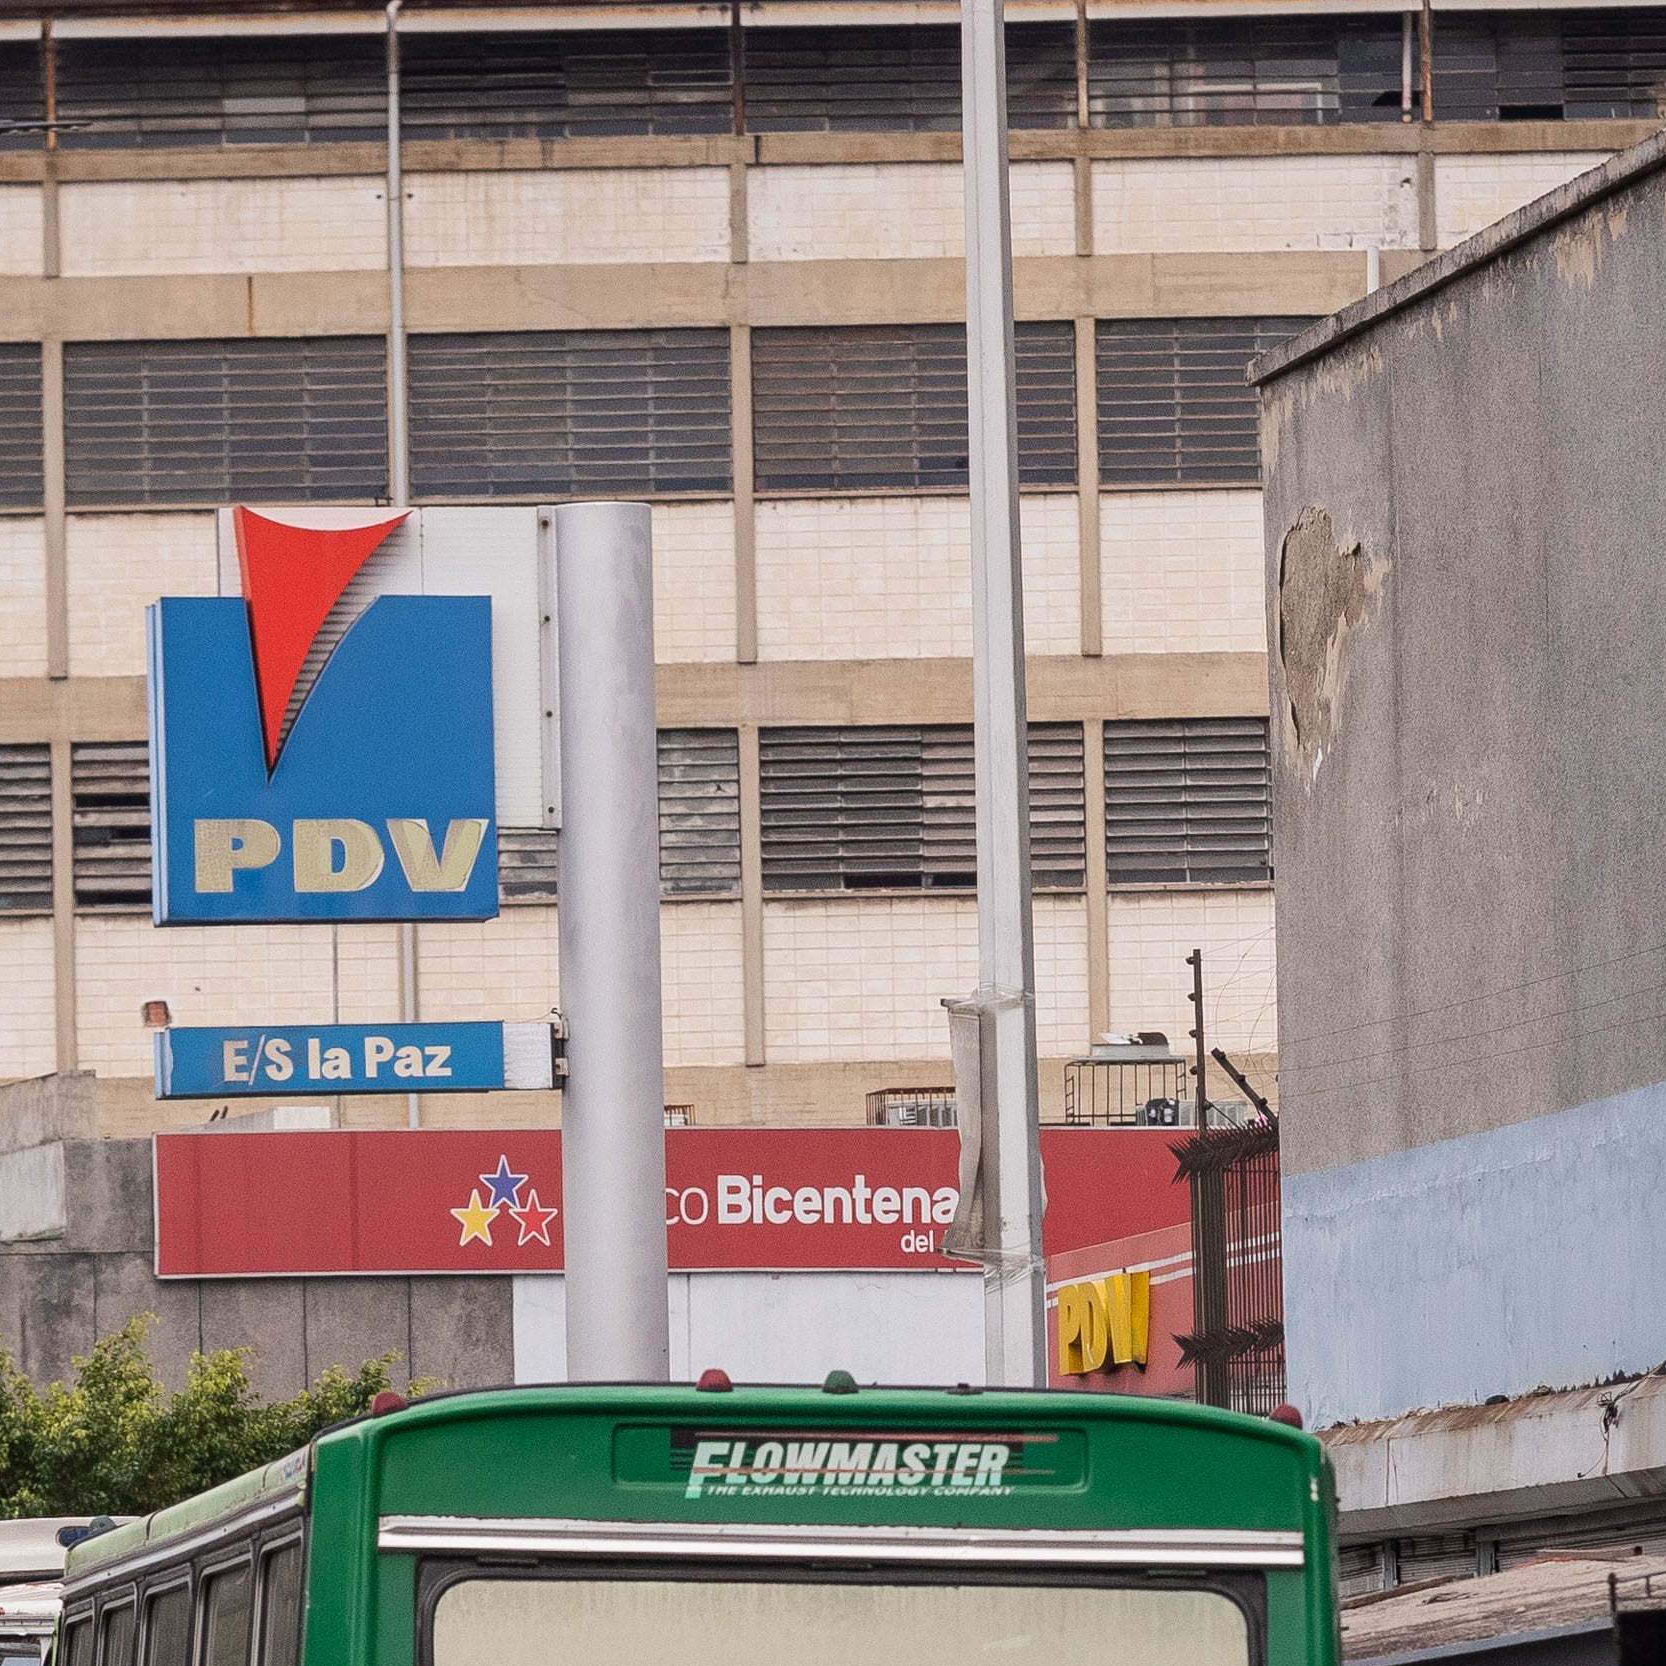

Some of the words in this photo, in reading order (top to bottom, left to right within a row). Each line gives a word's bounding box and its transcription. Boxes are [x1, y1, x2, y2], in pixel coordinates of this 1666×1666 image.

[193, 818, 489, 894] PDV
[222, 1034, 294, 1087] E/S
[307, 1037, 353, 1080] la
[363, 1036, 453, 1080] Paz
[716, 1174, 961, 1226] Bicentena
[899, 1229, 935, 1254] del
[684, 1441, 1011, 1499] FLOWMASTER
[706, 1485, 737, 1496] THE
[741, 1485, 818, 1497] EXHAUST
[821, 1485, 930, 1498] TECHNOLOGY
[932, 1485, 1017, 1497] COMPANY
